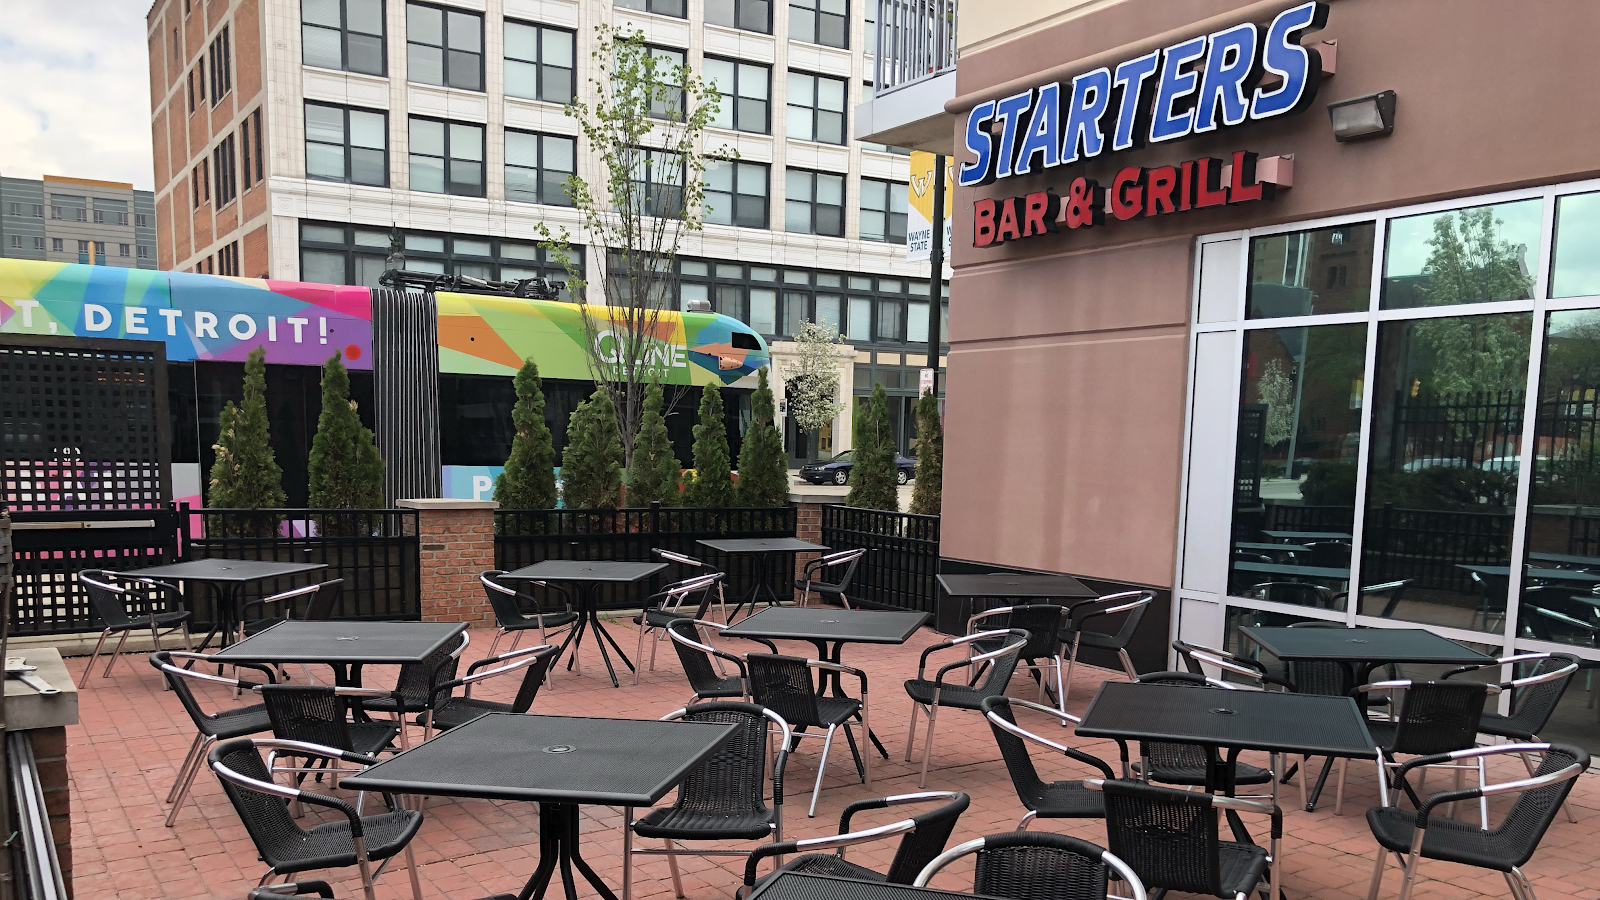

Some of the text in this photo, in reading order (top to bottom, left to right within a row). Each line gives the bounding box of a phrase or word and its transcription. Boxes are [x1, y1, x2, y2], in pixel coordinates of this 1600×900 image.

[958, 1, 1317, 186] STARTERS
[972, 151, 1262, 248] BAR & GRILL
[908, 229, 931, 241] WAYNE
[910, 240, 928, 252] STATE
[0, 299, 328, 345] T, DETROIT!
